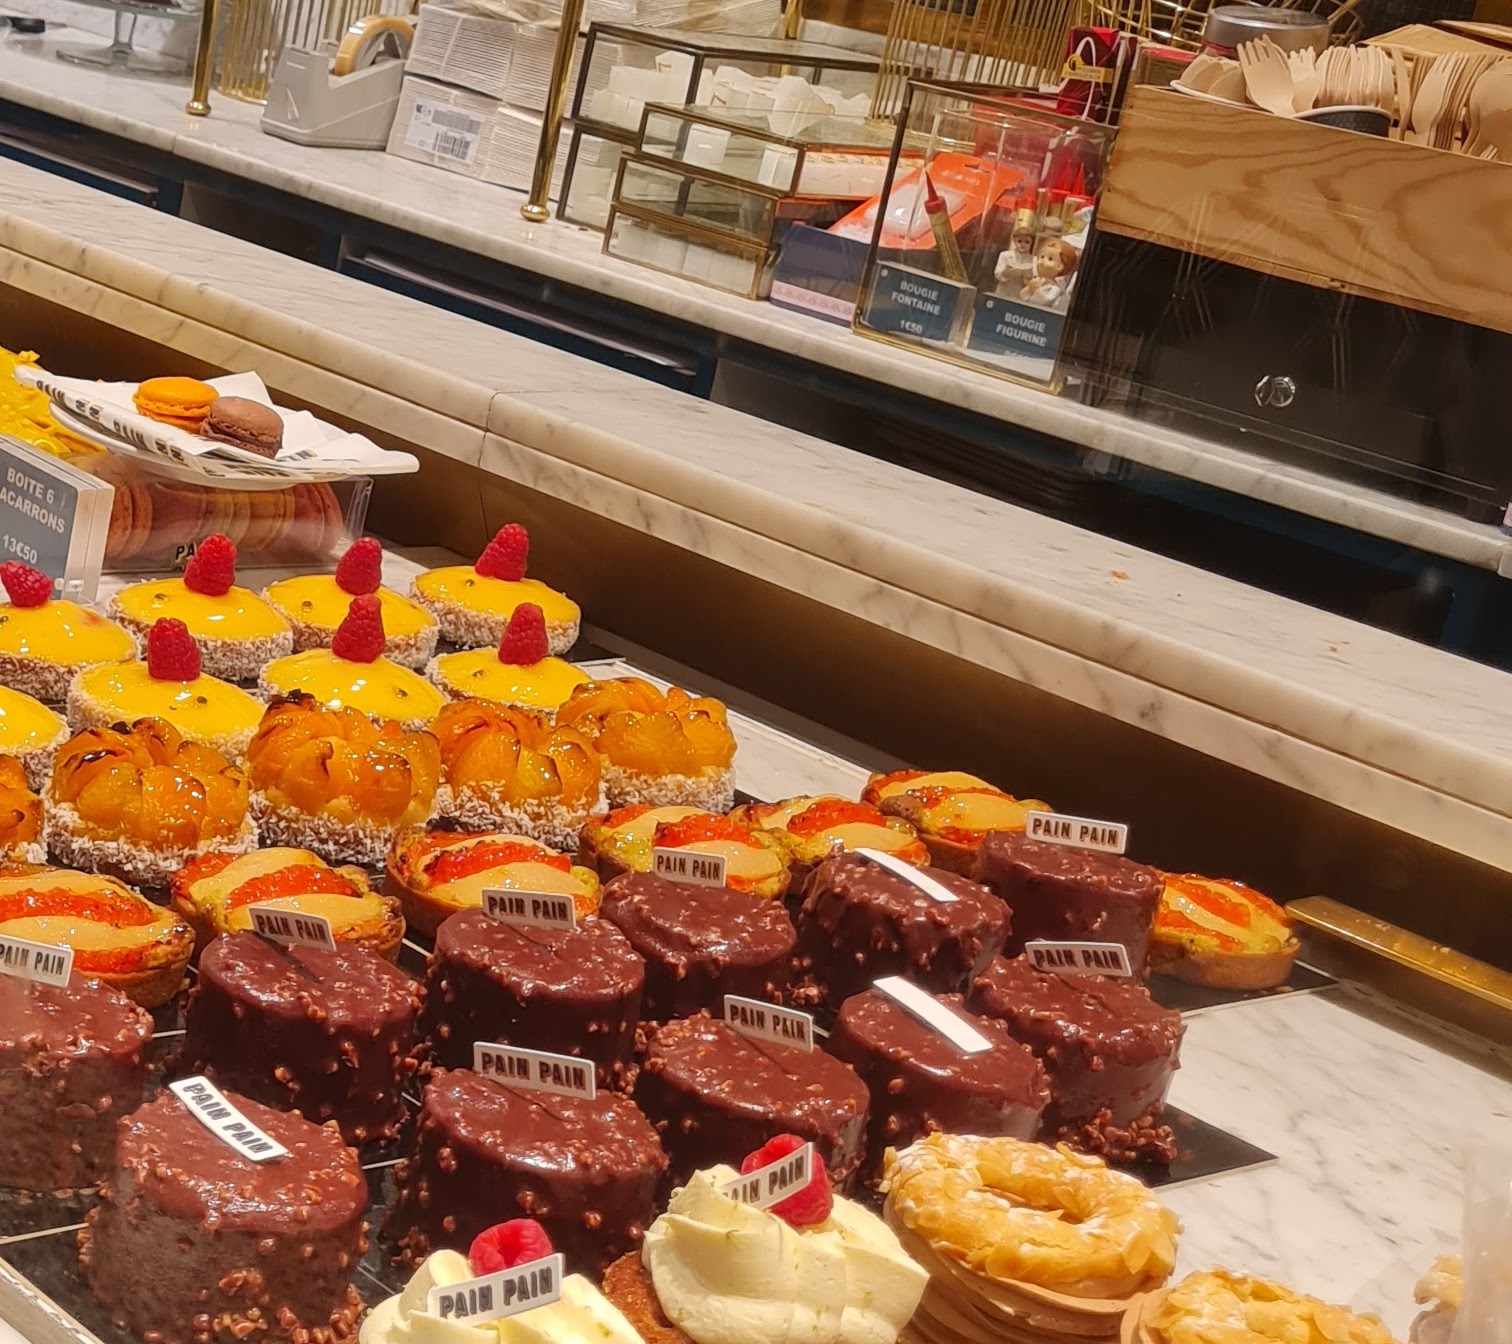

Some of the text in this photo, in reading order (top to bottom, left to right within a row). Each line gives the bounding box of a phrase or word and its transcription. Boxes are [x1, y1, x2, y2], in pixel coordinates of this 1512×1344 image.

[891, 292, 941, 315] FONTAINE
[900, 281, 938, 301] BOUGIE
[899, 320, 923, 334] 1€50
[995, 324, 1047, 347] FIGURINE
[1004, 312, 1046, 333] BOUGIE
[7, 467, 55, 504] BOITE 6
[2, 534, 38, 565] 13€50
[1032, 817, 1119, 846] PAIN PAIN
[656, 854, 721, 882] PAIN PAIN
[488, 894, 568, 923] PAIN PAIN
[255, 914, 329, 944] PAIN PAIN
[34, 951, 66, 975] PAIN
[1033, 948, 1122, 969] PAIN PAIN
[729, 1004, 806, 1041] PAIN PAIN
[480, 1051, 587, 1089] PAIN PAIN
[183, 1083, 274, 1155] PAIN PAIN
[768, 1154, 805, 1196] PAIN
[439, 1265, 554, 1320] PAIN PAIN
